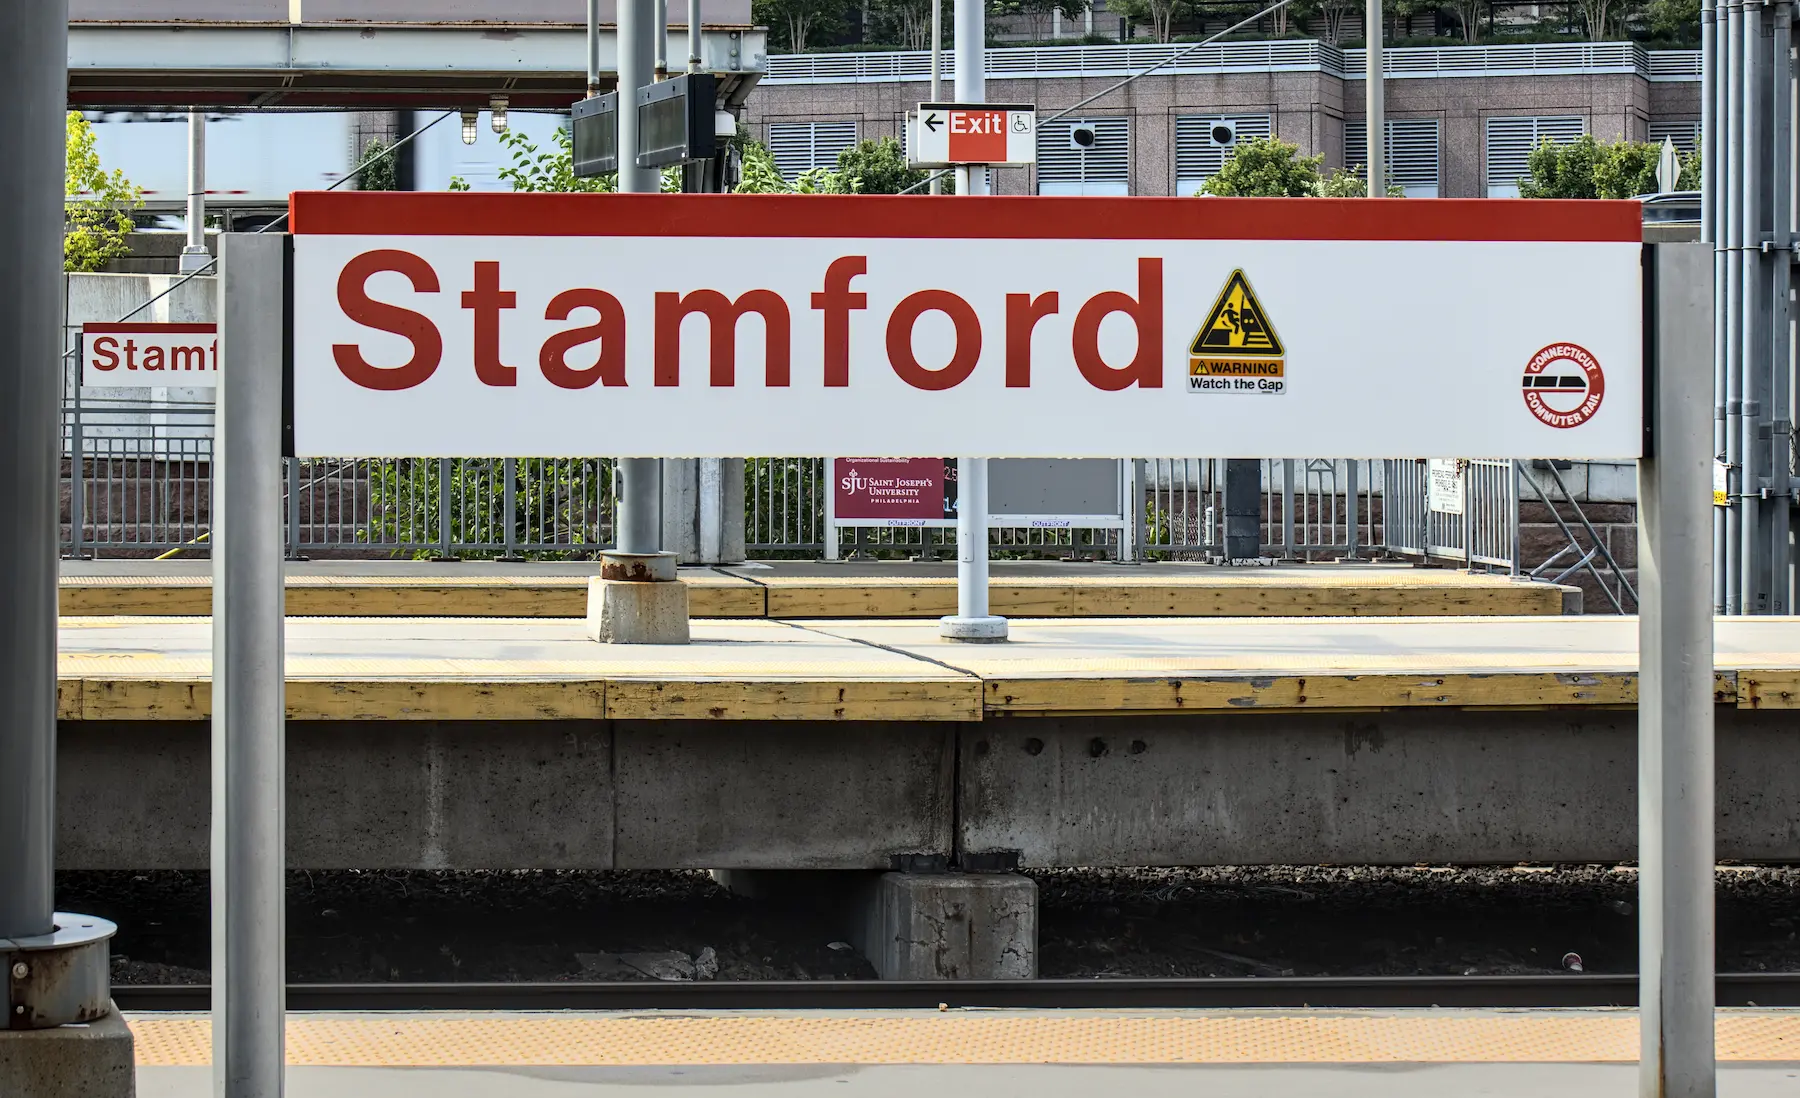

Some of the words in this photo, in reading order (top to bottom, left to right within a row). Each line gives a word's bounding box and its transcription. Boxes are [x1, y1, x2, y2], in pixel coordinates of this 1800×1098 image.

[950, 112, 1002, 134] Exit
[332, 248, 1164, 392] Stamford
[1530, 345, 1597, 372] CONNECTICUT
[1210, 362, 1278, 375] WARNING
[1190, 377, 1231, 389] Watch
[1234, 378, 1255, 390] the
[1257, 379, 1284, 392] Gap
[1526, 391, 1582, 426] COMMUTER
[1581, 393, 1600, 416] RAIL
[841, 476, 868, 495] SJU
[868, 477, 894, 487] SAINT
[868, 486, 920, 496] UNIVERSITY
